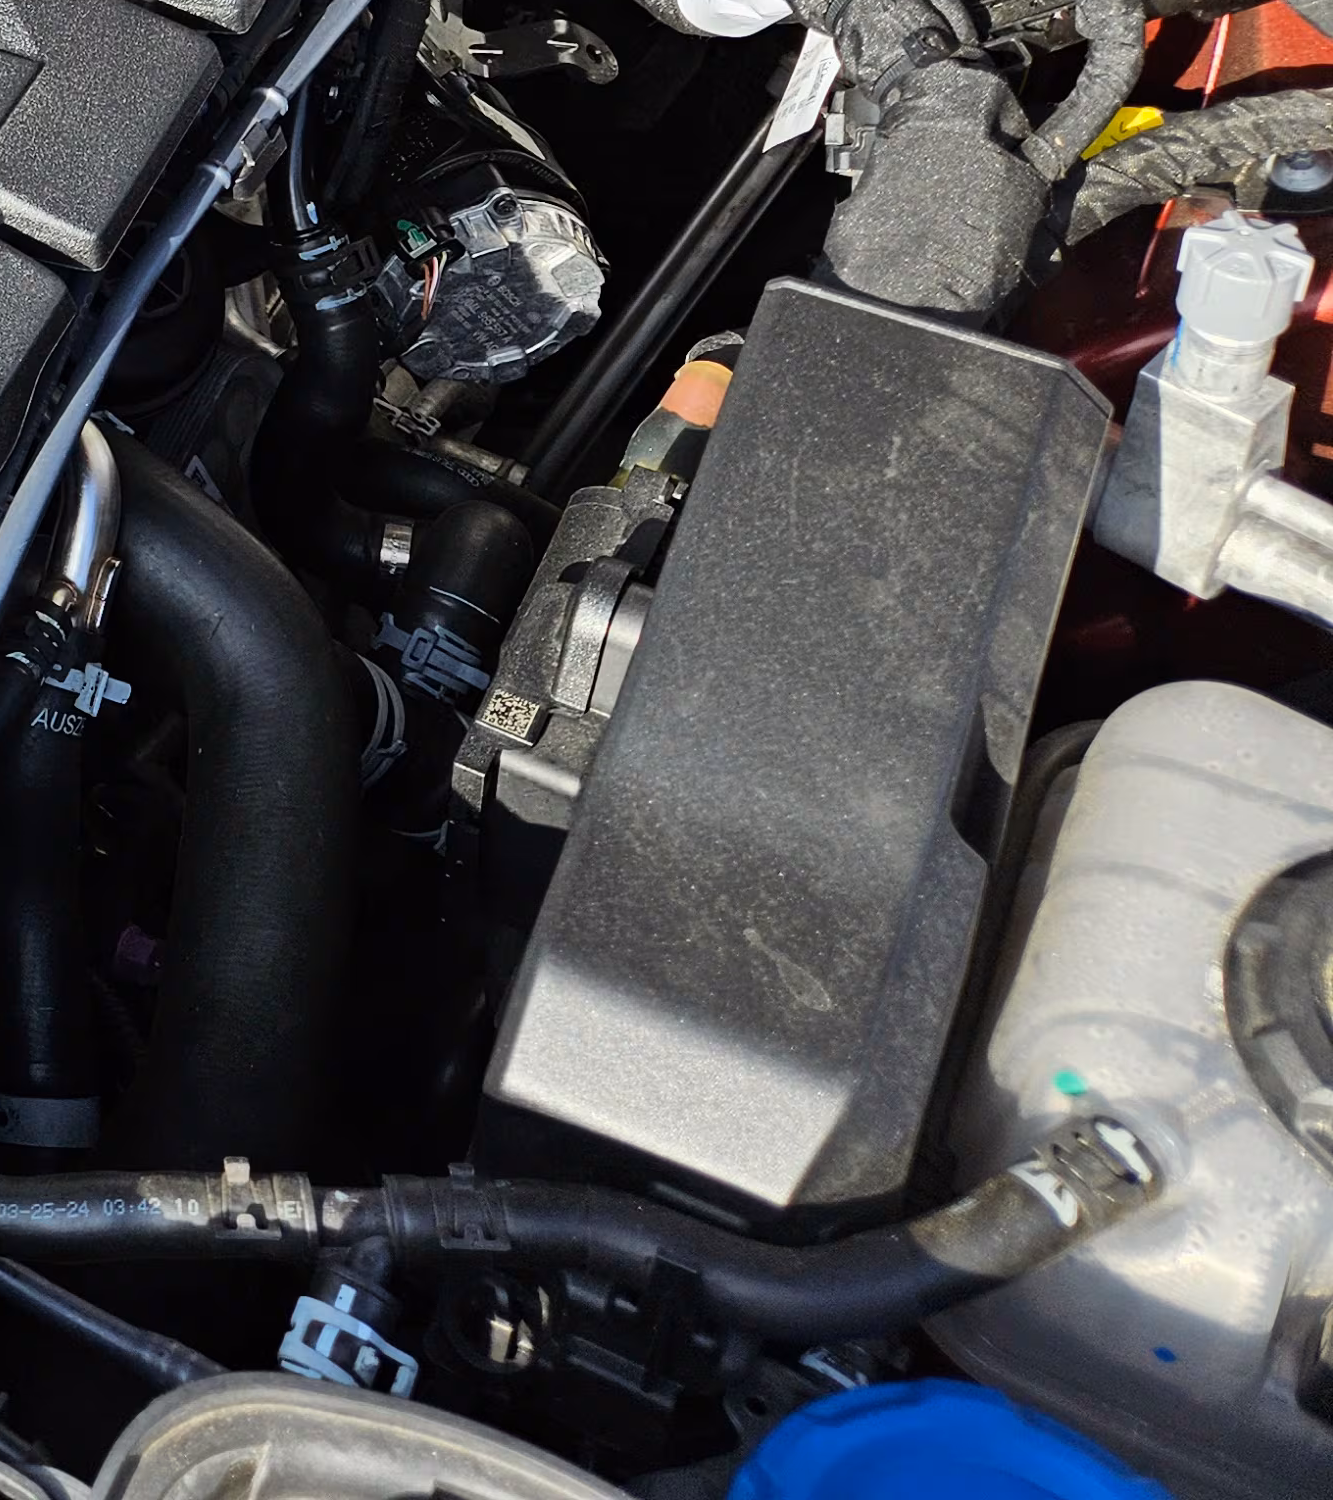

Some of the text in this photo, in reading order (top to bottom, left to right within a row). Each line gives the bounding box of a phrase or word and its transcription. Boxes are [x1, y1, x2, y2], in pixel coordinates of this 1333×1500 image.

[497, 284, 522, 307] BOSCH
[102, 1199, 163, 1216] 03:42
[173, 1199, 200, 1216] 10
